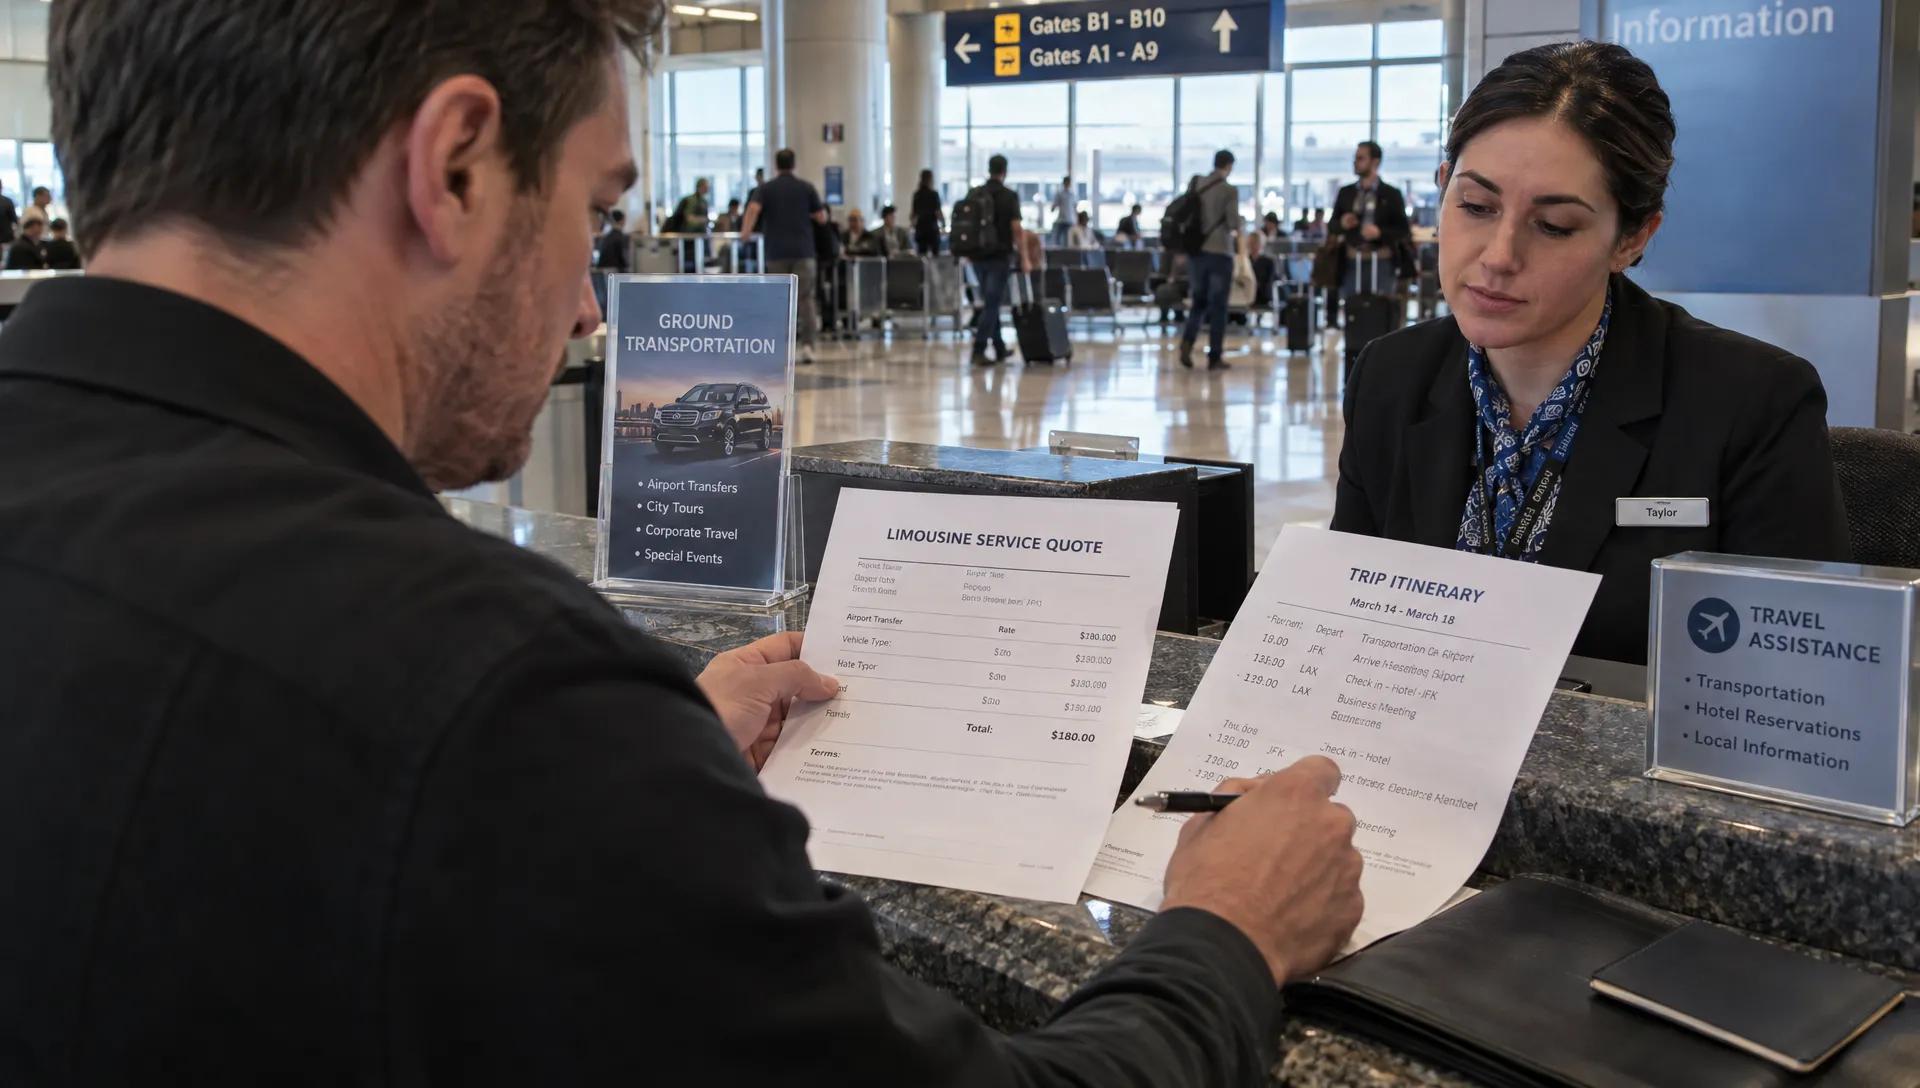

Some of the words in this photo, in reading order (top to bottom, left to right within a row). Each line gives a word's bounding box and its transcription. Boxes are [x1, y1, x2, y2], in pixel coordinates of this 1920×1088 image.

[1029, 15, 1081, 36] Gates
[1087, 12, 1110, 31] B1
[1129, 8, 1166, 29] B10
[1612, 2, 1835, 46] Information
[1029, 47, 1081, 66] Gates
[1087, 45, 1110, 64] A1
[1131, 42, 1159, 62] A9
[658, 313, 734, 330] GROUND
[625, 336, 776, 354] TRANSPORTATION
[647, 478, 685, 493] Airport
[687, 480, 738, 493] Transfers
[646, 500, 669, 515] City
[672, 502, 704, 514] Tours
[1646, 507, 1678, 519] Taylor
[645, 524, 701, 541] Corporate
[704, 527, 738, 540] Travel
[886, 528, 973, 546] LIMOUSINE
[976, 534, 1041, 550] SERVICE
[1046, 538, 1103, 554] QUOTE
[644, 548, 684, 563] Special
[686, 551, 723, 565] Events
[1349, 567, 1388, 585] TRIP
[1390, 574, 1485, 604] ITINERARY
[846, 613, 872, 625] Airport
[873, 616, 903, 626] Transfer
[1350, 597, 1382, 613] March
[1384, 604, 1397, 615] 14
[1405, 607, 1438, 624] March
[1441, 613, 1455, 625] 18
[1749, 606, 1825, 630] TRAVEL
[998, 626, 1016, 635] Rate
[1315, 624, 1344, 639] Depart
[842, 635, 868, 647] Vehicle
[1361, 633, 1426, 656] Transportation
[1748, 632, 1882, 664] ASSISTANCE
[1308, 644, 1326, 657] JFK
[1352, 653, 1382, 669] Arrive
[1300, 664, 1318, 677] LAX
[1292, 684, 1311, 698] LAX
[1345, 674, 1372, 690] Check
[1373, 680, 1383, 691] in
[1392, 684, 1417, 699] Hotel
[1696, 673, 1826, 707] Transportation
[1337, 694, 1377, 711] Business
[1378, 703, 1417, 720] Meeting
[1695, 701, 1740, 722] Hotel
[1745, 709, 1862, 742] Reservations
[966, 723, 993, 735] Total:
[1051, 730, 1096, 744] $180.00
[809, 748, 841, 759] Terms:
[1266, 745, 1286, 758] JFK
[1694, 730, 1737, 750] Local
[1743, 738, 1850, 771] Information
[1365, 753, 1391, 766] Hotel
